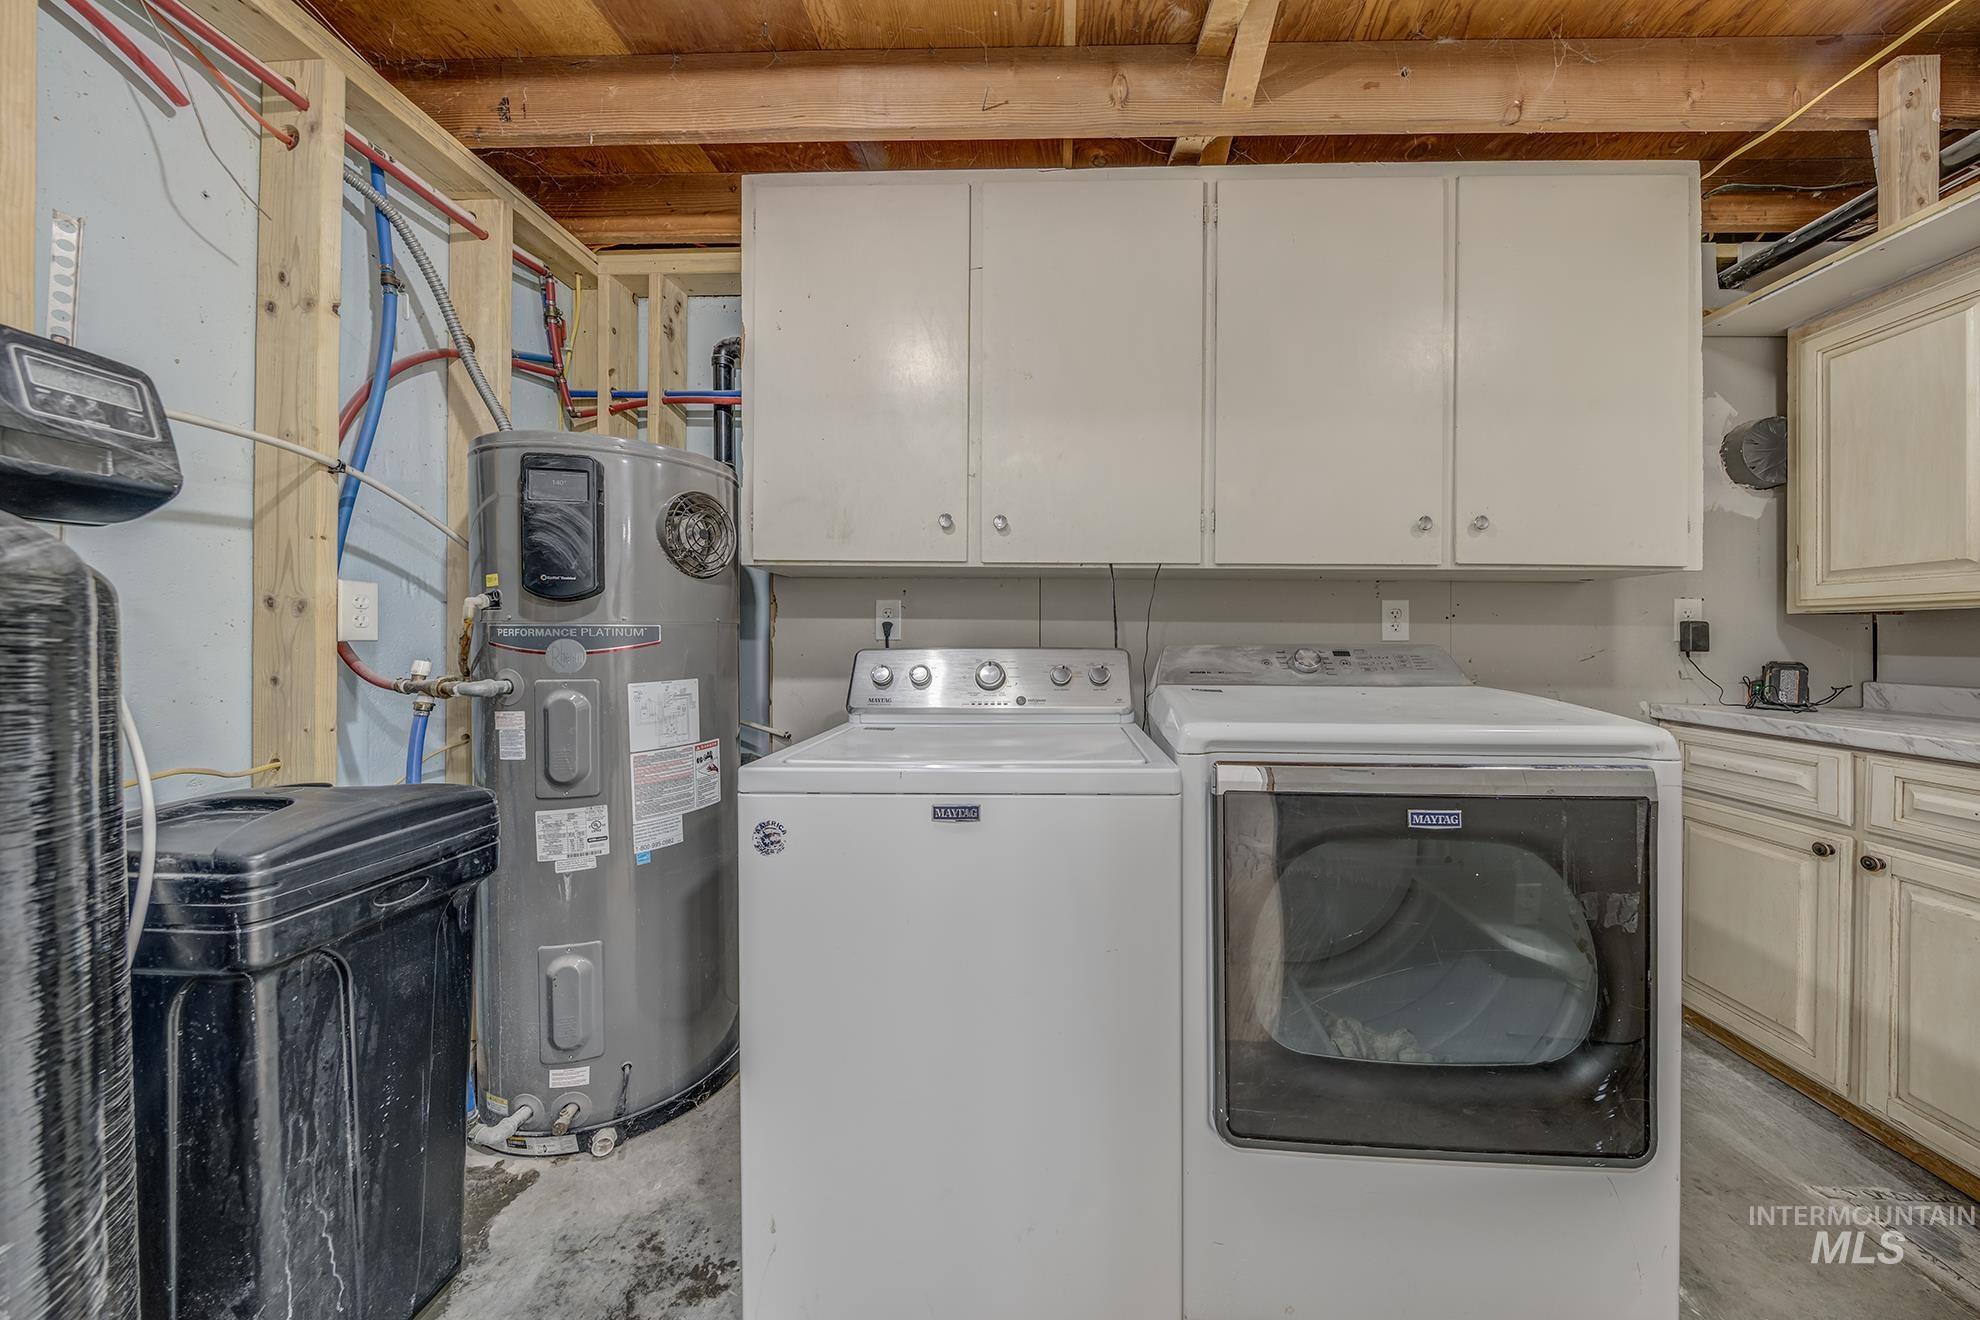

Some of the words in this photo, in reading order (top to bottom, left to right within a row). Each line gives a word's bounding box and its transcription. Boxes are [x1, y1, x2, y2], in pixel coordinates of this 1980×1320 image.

[497, 628, 577, 637] PERFORMANCE
[935, 808, 978, 819] MAYTAG
[1412, 814, 1459, 825] MAYTAG
